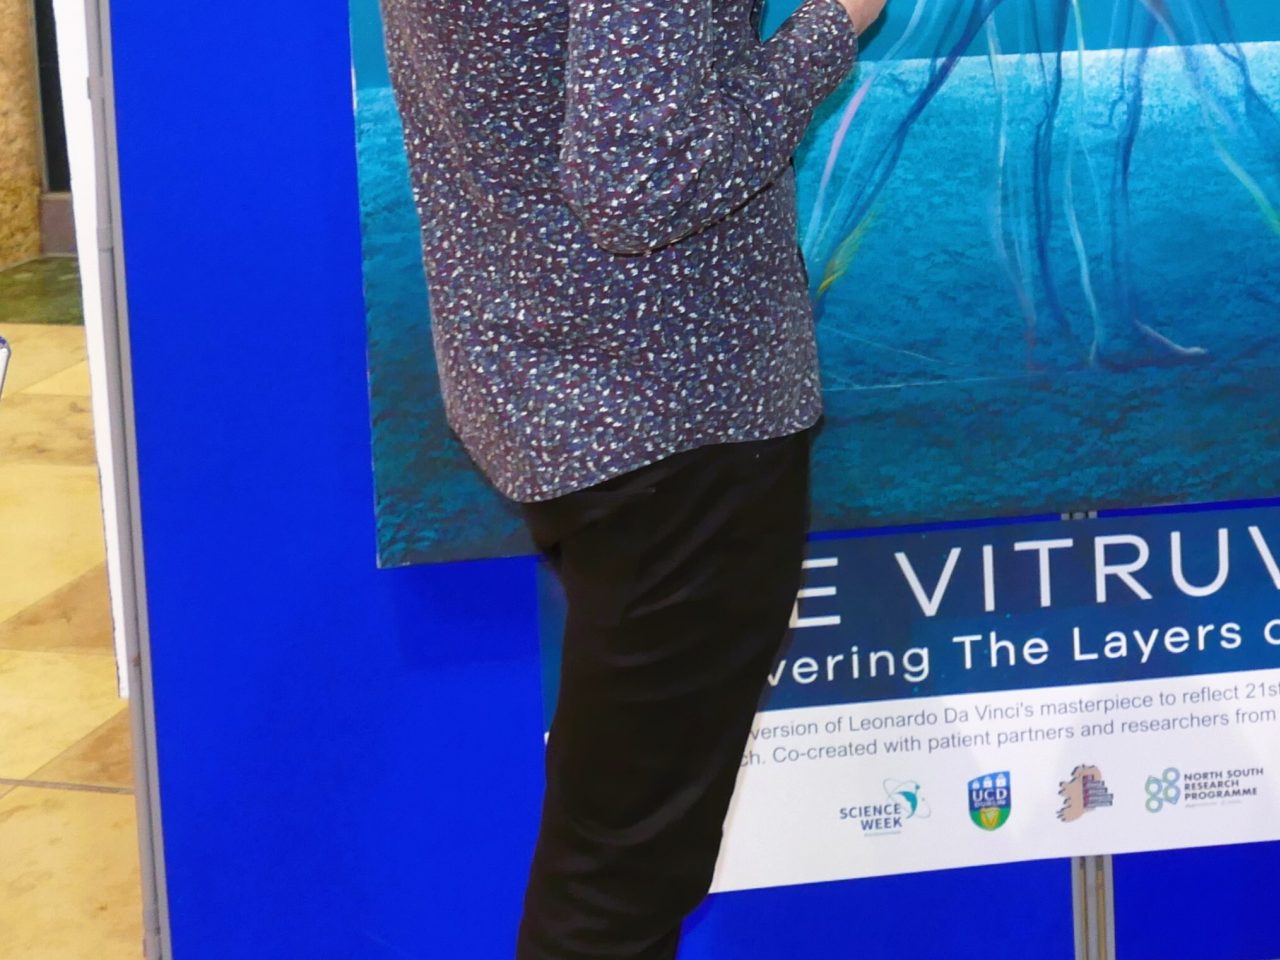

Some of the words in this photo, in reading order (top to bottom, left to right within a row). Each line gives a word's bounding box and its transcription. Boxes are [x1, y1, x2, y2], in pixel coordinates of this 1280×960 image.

[952, 630, 1050, 670] The
[1072, 622, 1242, 664] Layers
[749, 720, 819, 740] version
[825, 716, 844, 735] of
[849, 709, 938, 732] Leonardo
[944, 707, 969, 725] Da
[975, 702, 1035, 721] Vinci's
[1040, 692, 1154, 717] masterpiece
[1159, 690, 1177, 707] to
[1182, 684, 1239, 704] reflect
[772, 740, 878, 764] Co-created
[883, 735, 922, 754] with
[928, 730, 992, 753] patient
[997, 726, 1075, 747] partners
[1080, 719, 1115, 738] and
[1120, 711, 1230, 734] researchers
[1235, 708, 1277, 726] from
[1183, 771, 1223, 781] NORTH
[1227, 767, 1264, 778] SOUTH
[1183, 779, 1240, 791] RESEARCH
[972, 788, 1008, 802] UCD
[1183, 787, 1258, 801] PROGRAMME
[839, 803, 902, 820] SCIENCE
[860, 817, 903, 831] WEEK
